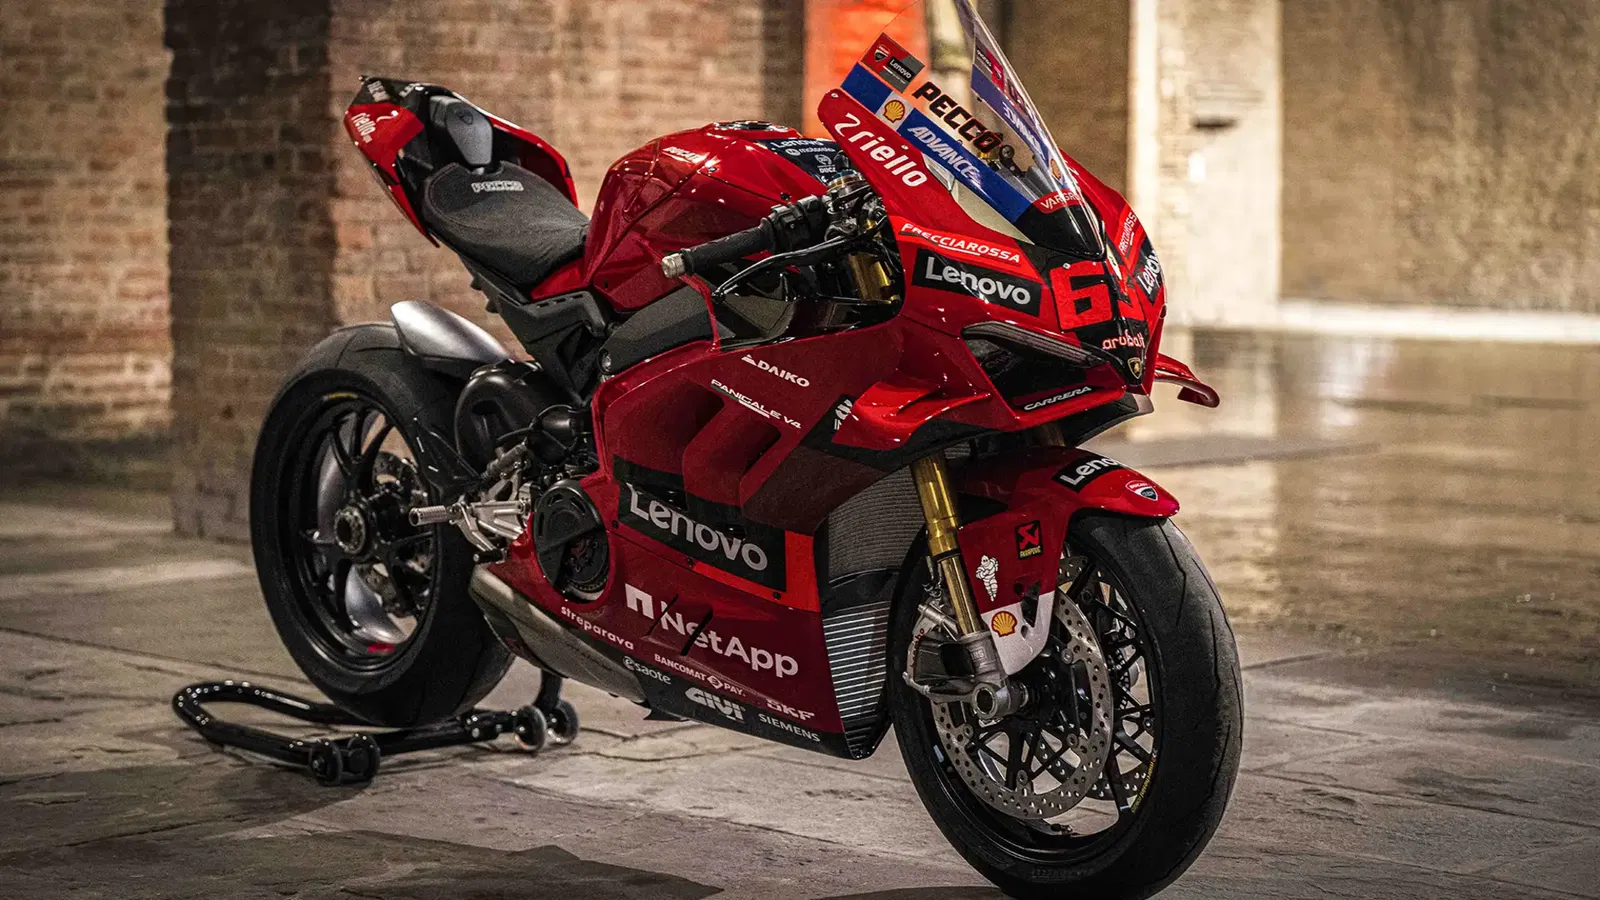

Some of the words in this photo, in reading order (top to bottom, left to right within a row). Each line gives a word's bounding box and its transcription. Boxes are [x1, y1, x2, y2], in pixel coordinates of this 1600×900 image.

[889, 59, 912, 79] Lenovo
[911, 81, 1002, 154] PECCO
[907, 126, 980, 179] ADVANCE
[901, 223, 1020, 263] FRECCIAROSSA
[925, 256, 1031, 305] Lenovo
[757, 360, 810, 387] DAIKO
[711, 379, 782, 419] PANIGALE
[783, 416, 802, 429] V4
[1024, 386, 1092, 411] CARRERA
[626, 483, 768, 571] Lenovo
[561, 605, 634, 650] streparava
[660, 600, 799, 678] NetApp
[623, 655, 671, 685] esaote
[654, 653, 707, 681] BANCOMAT
[758, 713, 821, 743] SIEMENS
[766, 698, 815, 721] SKF
